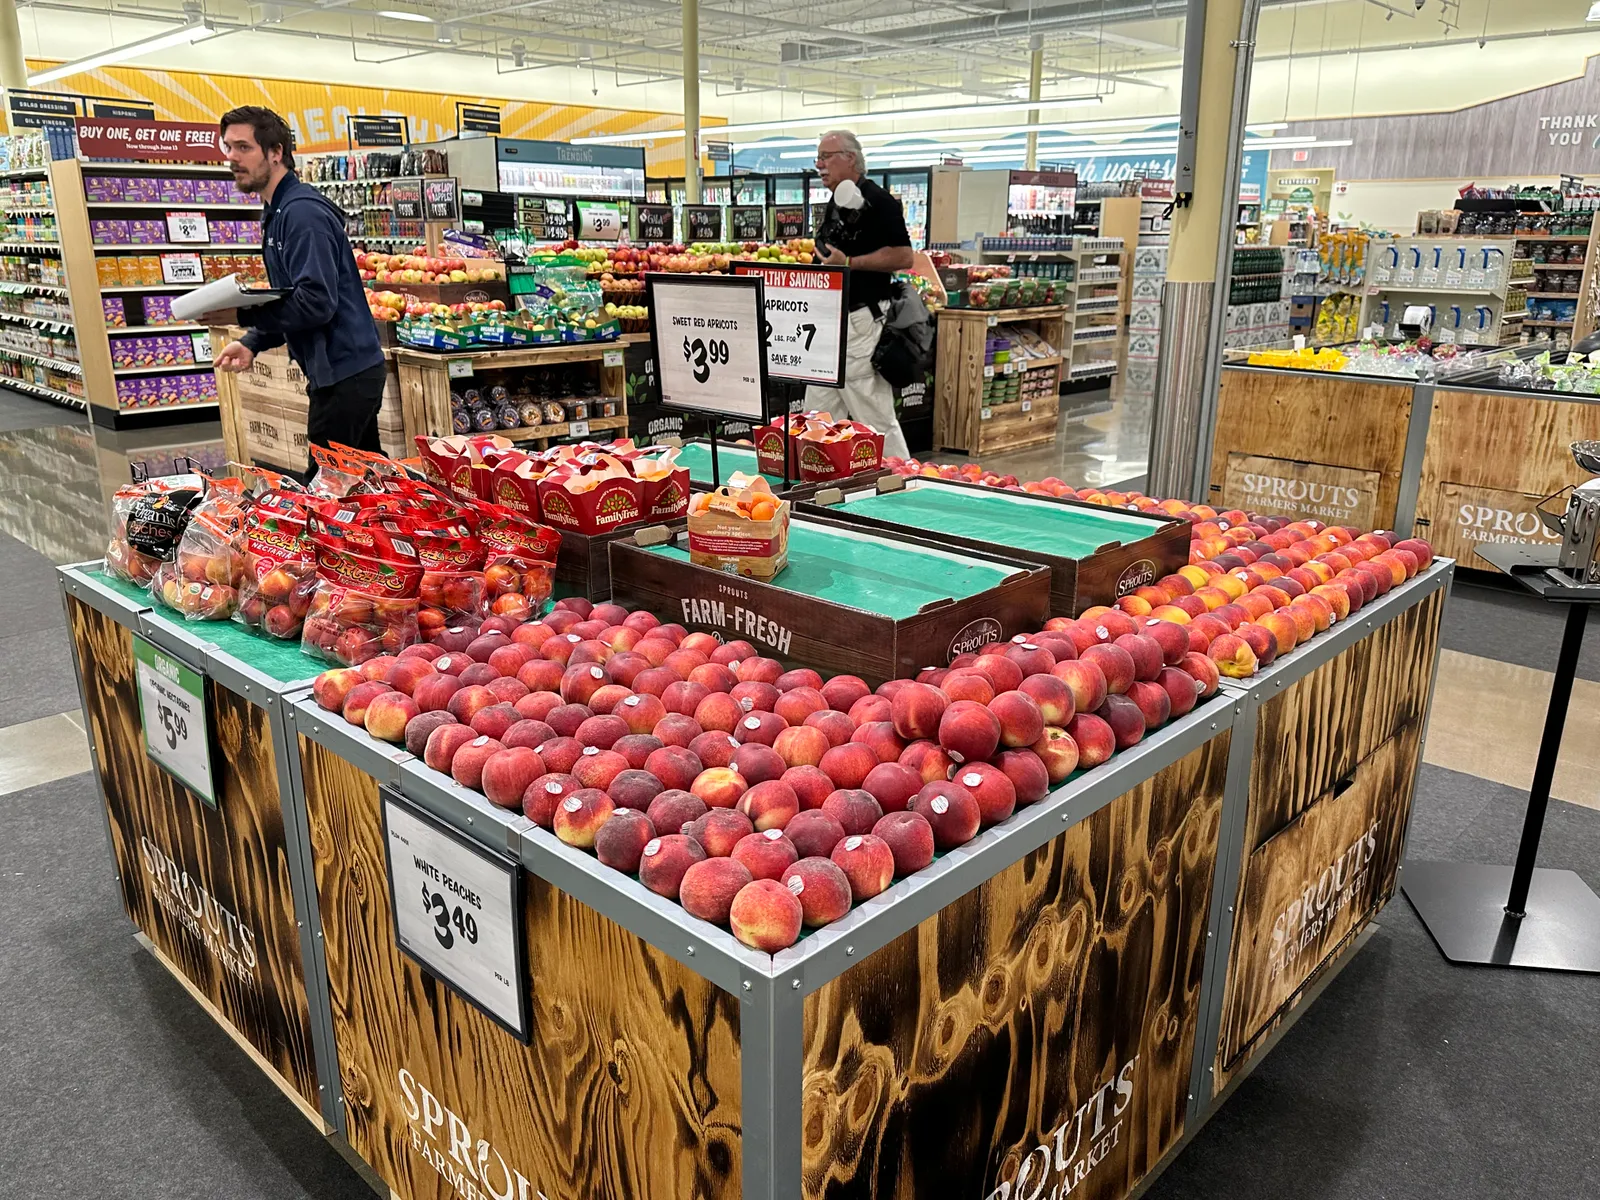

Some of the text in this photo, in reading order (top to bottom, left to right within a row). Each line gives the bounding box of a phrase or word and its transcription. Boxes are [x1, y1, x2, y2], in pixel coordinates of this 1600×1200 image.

[112, 109, 137, 118] HISPANIC
[1540, 114, 1598, 130] THANK
[79, 125, 216, 144] BUY ONE, GET ONE FREE!
[1548, 131, 1582, 146] YOU
[139, 143, 160, 151] through
[556, 146, 593, 163] TRENDING
[747, 269, 831, 289] LTHY SAVINGS
[765, 298, 809, 314] APRICOTS
[672, 315, 738, 331] SWEET RED APRICOTS
[774, 334, 786, 343] LBS.
[786, 335, 797, 343] FOR
[796, 323, 817, 352] $7
[770, 353, 788, 364] SAVE
[249, 420, 279, 442] FARM-FRESH
[648, 416, 683, 435] ORGANIC
[1243, 473, 1359, 508] SPROUTS
[1246, 494, 1352, 519] FARMERS MARKET
[718, 584, 749, 600] SPROUTS
[1117, 570, 1153, 596] SPROUTS
[681, 598, 793, 656] FARM-FRESH
[952, 630, 998, 657] SPROUTS
[154, 653, 181, 685] ORGANIC
[413, 854, 482, 911] WHITE PEACHES
[1269, 819, 1382, 959] SPROUTS
[142, 836, 256, 968] SPROUTS
[151, 880, 255, 989] FARMERS MARKET
[1270, 866, 1369, 982] FARMERS MARKET
[494, 970, 510, 987] PER LB
